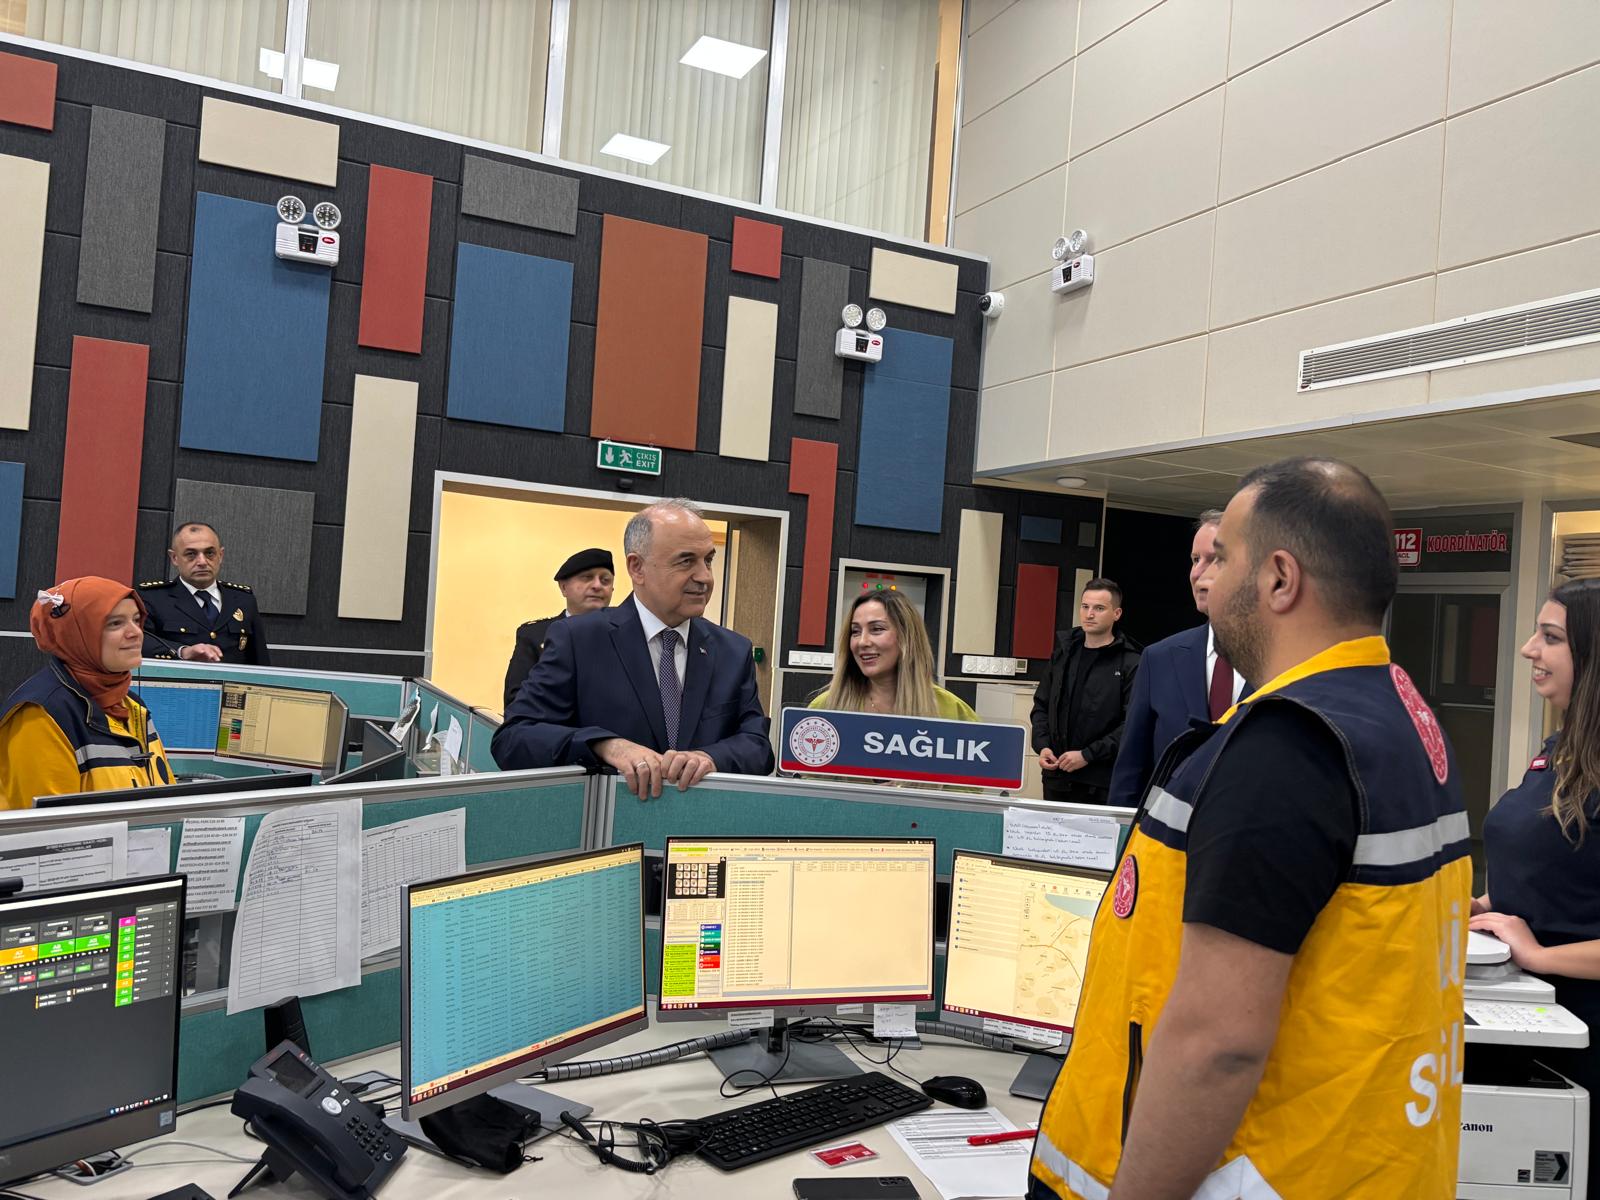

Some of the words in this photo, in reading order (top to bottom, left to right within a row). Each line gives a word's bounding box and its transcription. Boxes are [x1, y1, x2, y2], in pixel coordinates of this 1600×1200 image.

[636, 461, 656, 469] EXIT
[1394, 533, 1417, 550] 112
[1426, 529, 1508, 553] KOORDİNATÖR
[863, 728, 991, 763] SAĞLIK
[1460, 1122, 1493, 1133] anon
